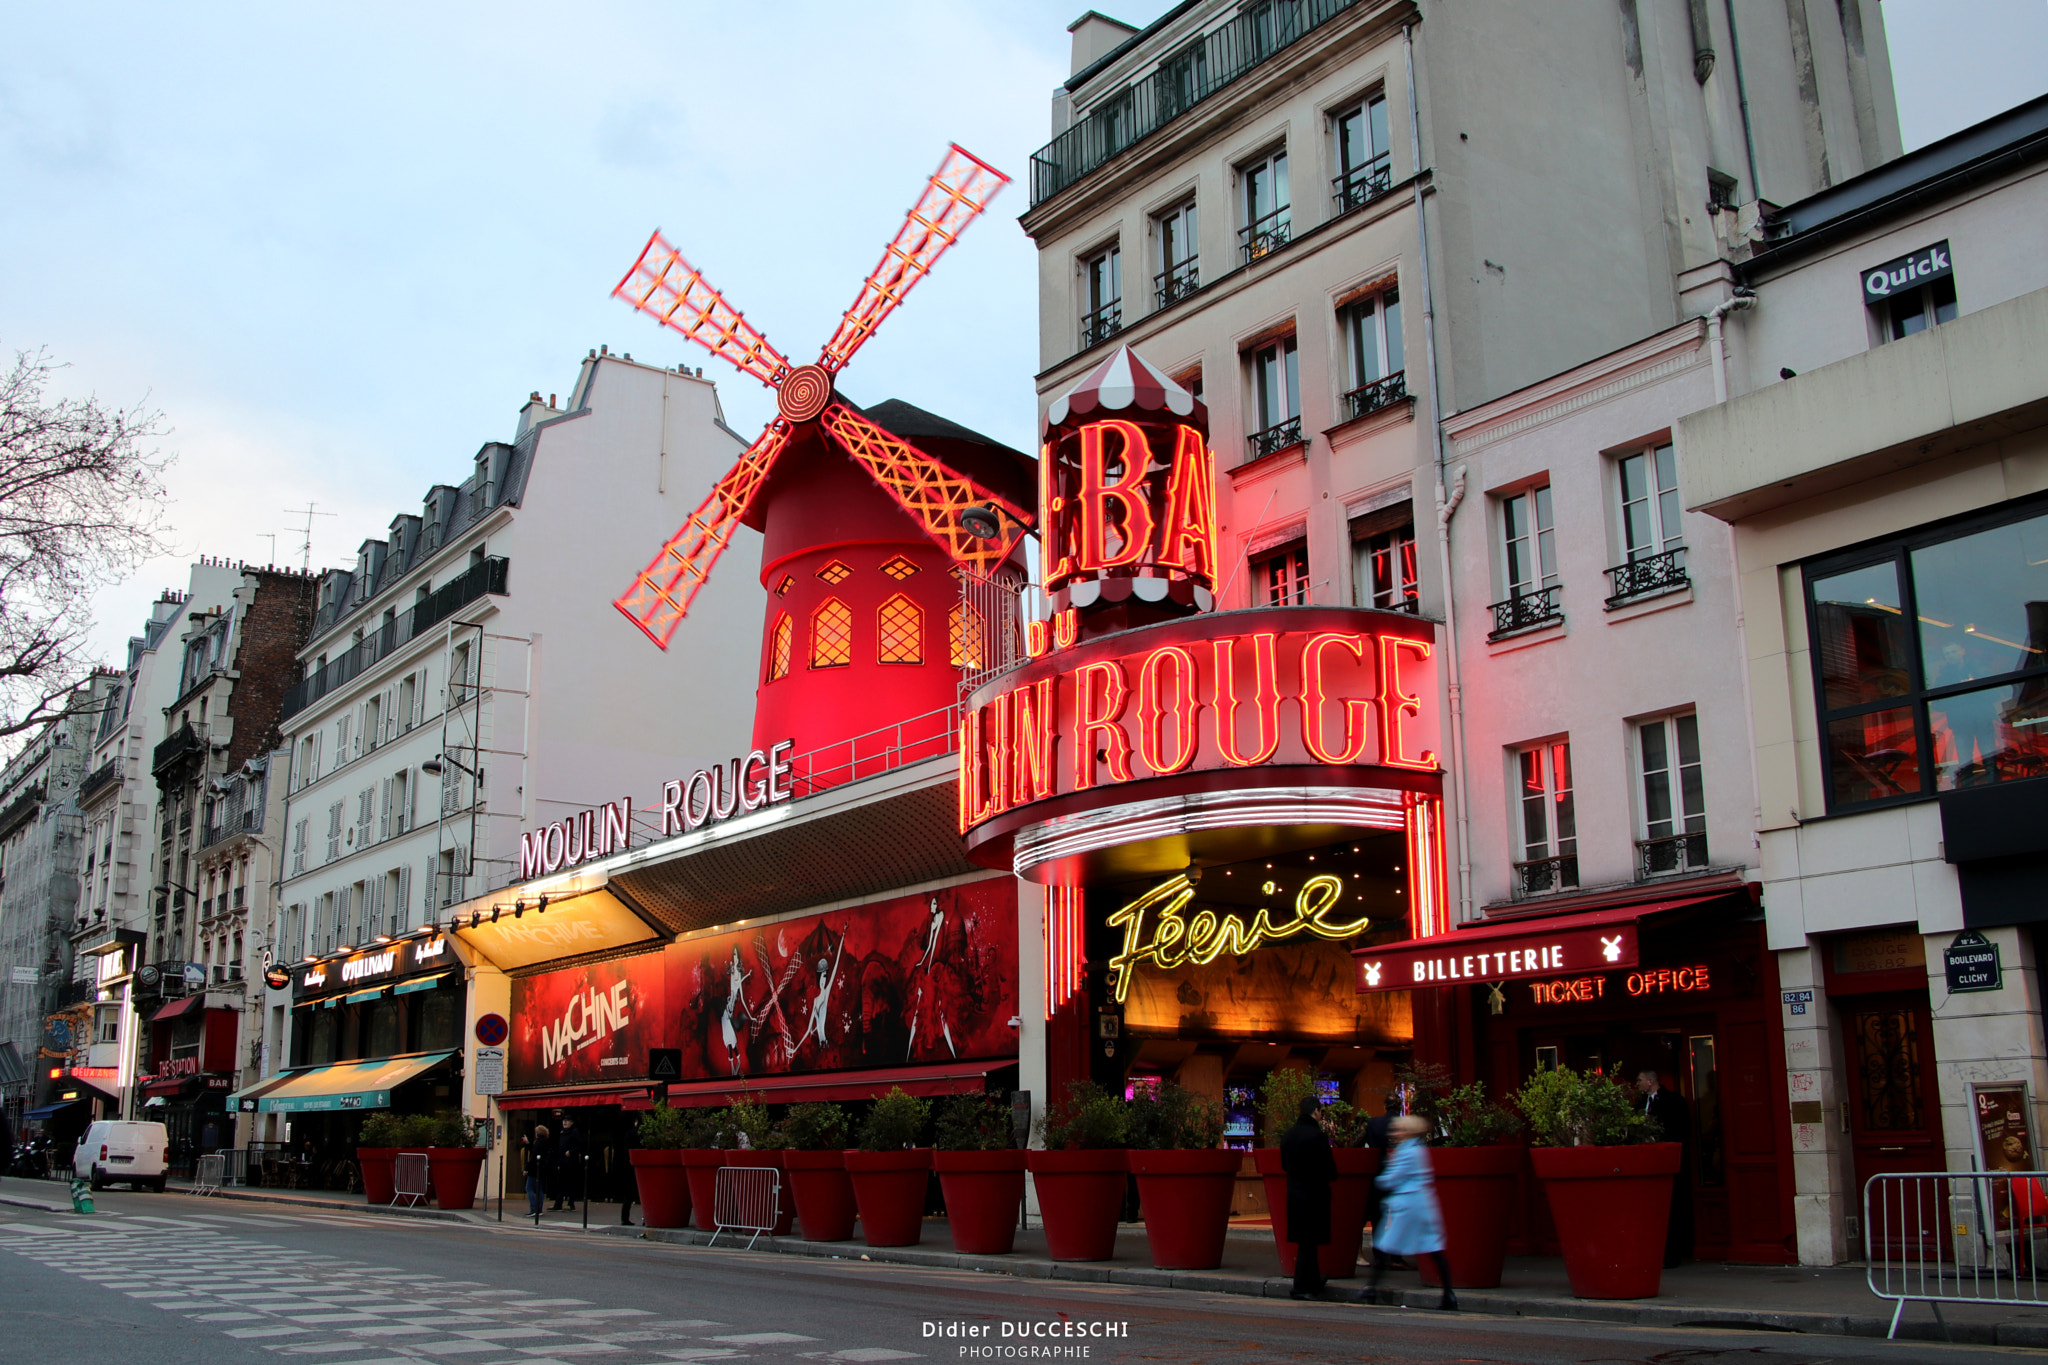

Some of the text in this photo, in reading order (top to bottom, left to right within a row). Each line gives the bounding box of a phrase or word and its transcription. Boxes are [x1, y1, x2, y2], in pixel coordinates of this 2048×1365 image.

[1866, 248, 1950, 295] Quick
[1029, 608, 1078, 658] DU
[1074, 632, 1438, 793] ROUGE
[519, 739, 795, 880] MOULIN ROUGE
[1107, 874, 1368, 1003] Féerie
[1413, 944, 1564, 983] BILLETTERIE
[1949, 953, 1993, 966] BOULEVARD
[1958, 973, 1988, 984] CLICHY
[1530, 965, 1711, 1004] TICKET OFFICE
[1784, 992, 1810, 1002] 82 84
[541, 978, 630, 1070] MACHINE
[1792, 1004, 1804, 1014] 86
[171, 1056, 196, 1077] STATION
[209, 1078, 229, 1088] BAR
